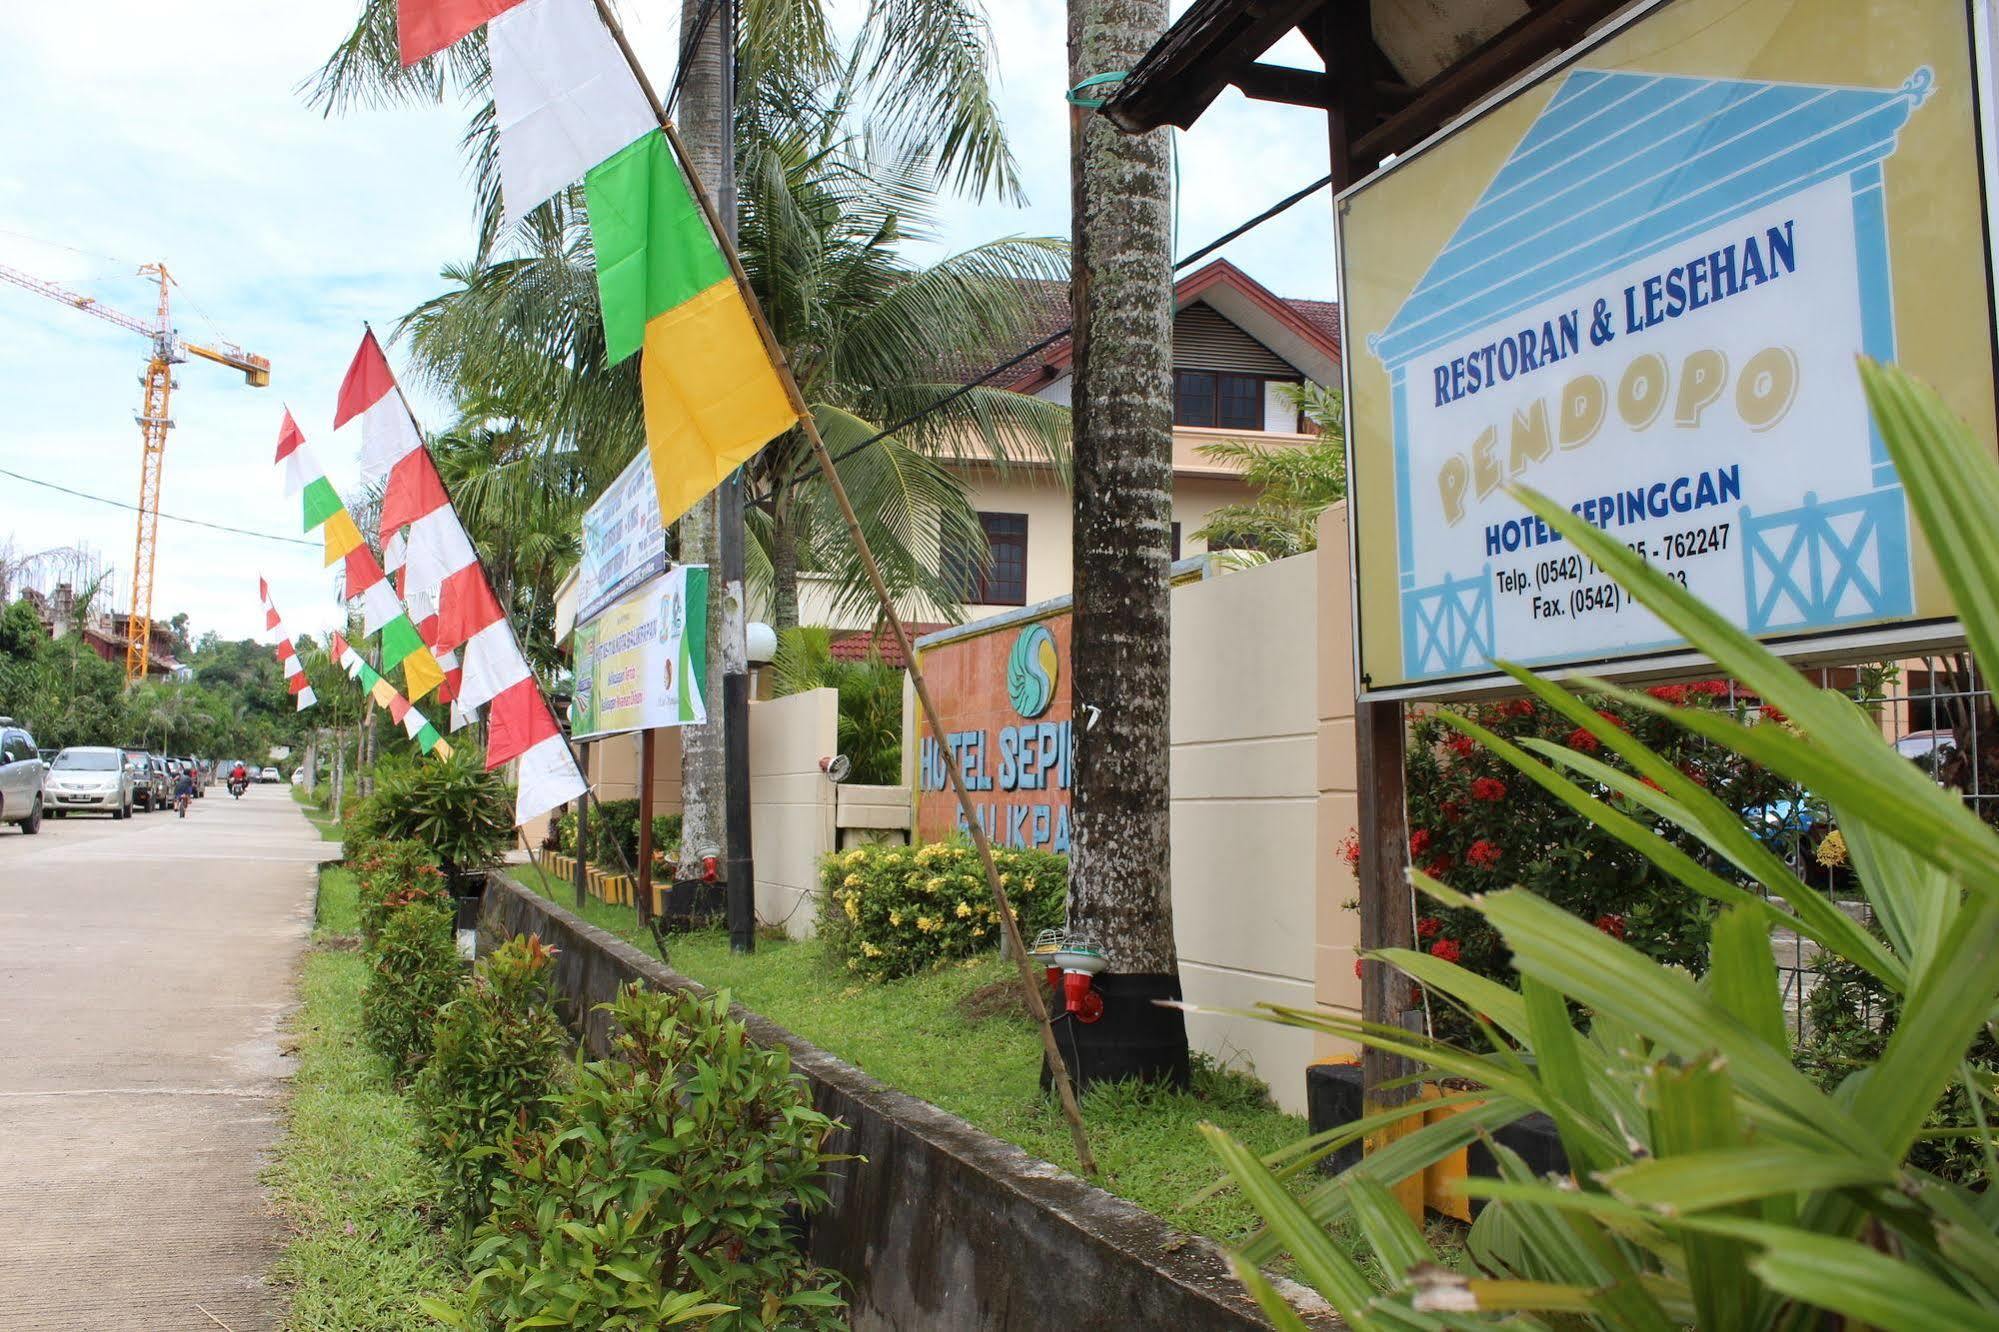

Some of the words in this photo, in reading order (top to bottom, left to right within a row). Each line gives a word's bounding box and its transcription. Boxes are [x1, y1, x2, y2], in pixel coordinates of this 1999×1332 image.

[1433, 309, 1579, 408] RESTORAN
[1589, 298, 1615, 347] &
[1623, 220, 1796, 335] LESEHAN
[1438, 345, 1800, 529] PENDOPO
[1496, 568, 1531, 595] Telp.
[1535, 554, 1583, 592] (0542)
[1663, 522, 1730, 561] 762247
[1533, 596, 1565, 620] Fax.
[1570, 583, 1620, 620] (0542)
[920, 729, 994, 793] HOTEL
